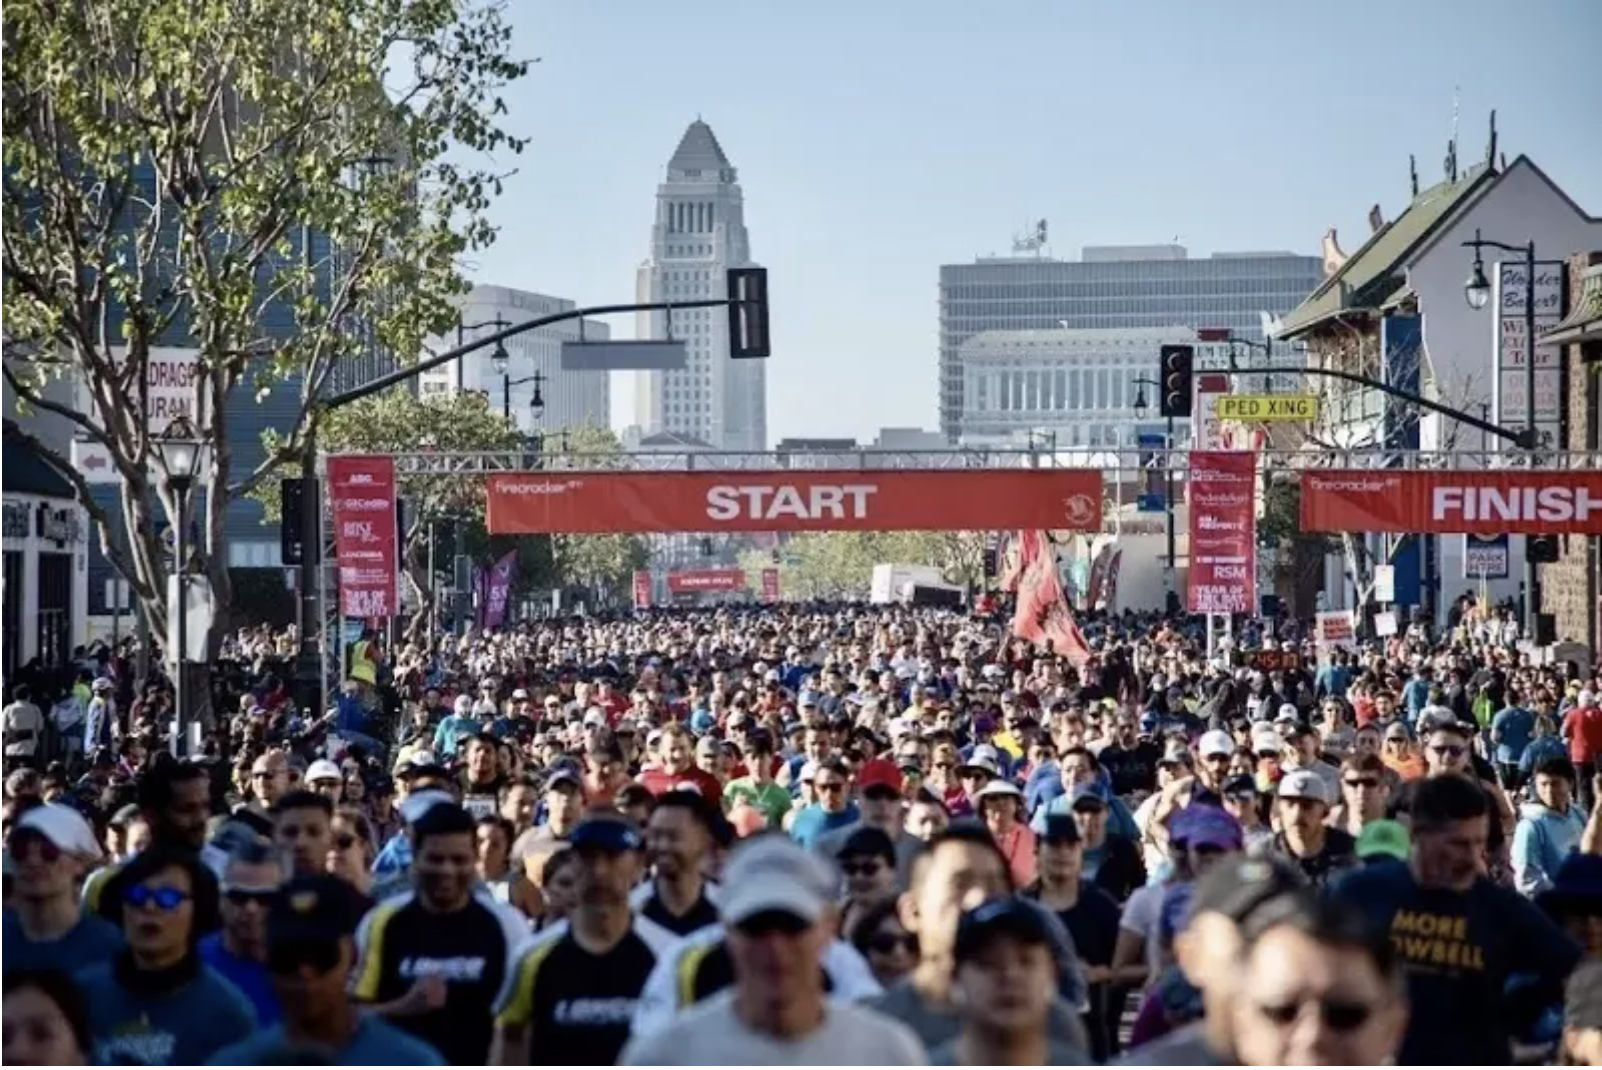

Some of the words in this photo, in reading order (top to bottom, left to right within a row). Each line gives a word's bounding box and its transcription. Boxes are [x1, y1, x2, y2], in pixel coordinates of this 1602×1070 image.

[1224, 400, 1260, 415] PED
[1268, 400, 1309, 415] XING
[706, 485, 878, 521] START
[1433, 486, 1602, 522] FINISH
[1213, 566, 1246, 579] RSM
[1390, 908, 1468, 939] MORE
[1387, 935, 1486, 971] OWBELL
